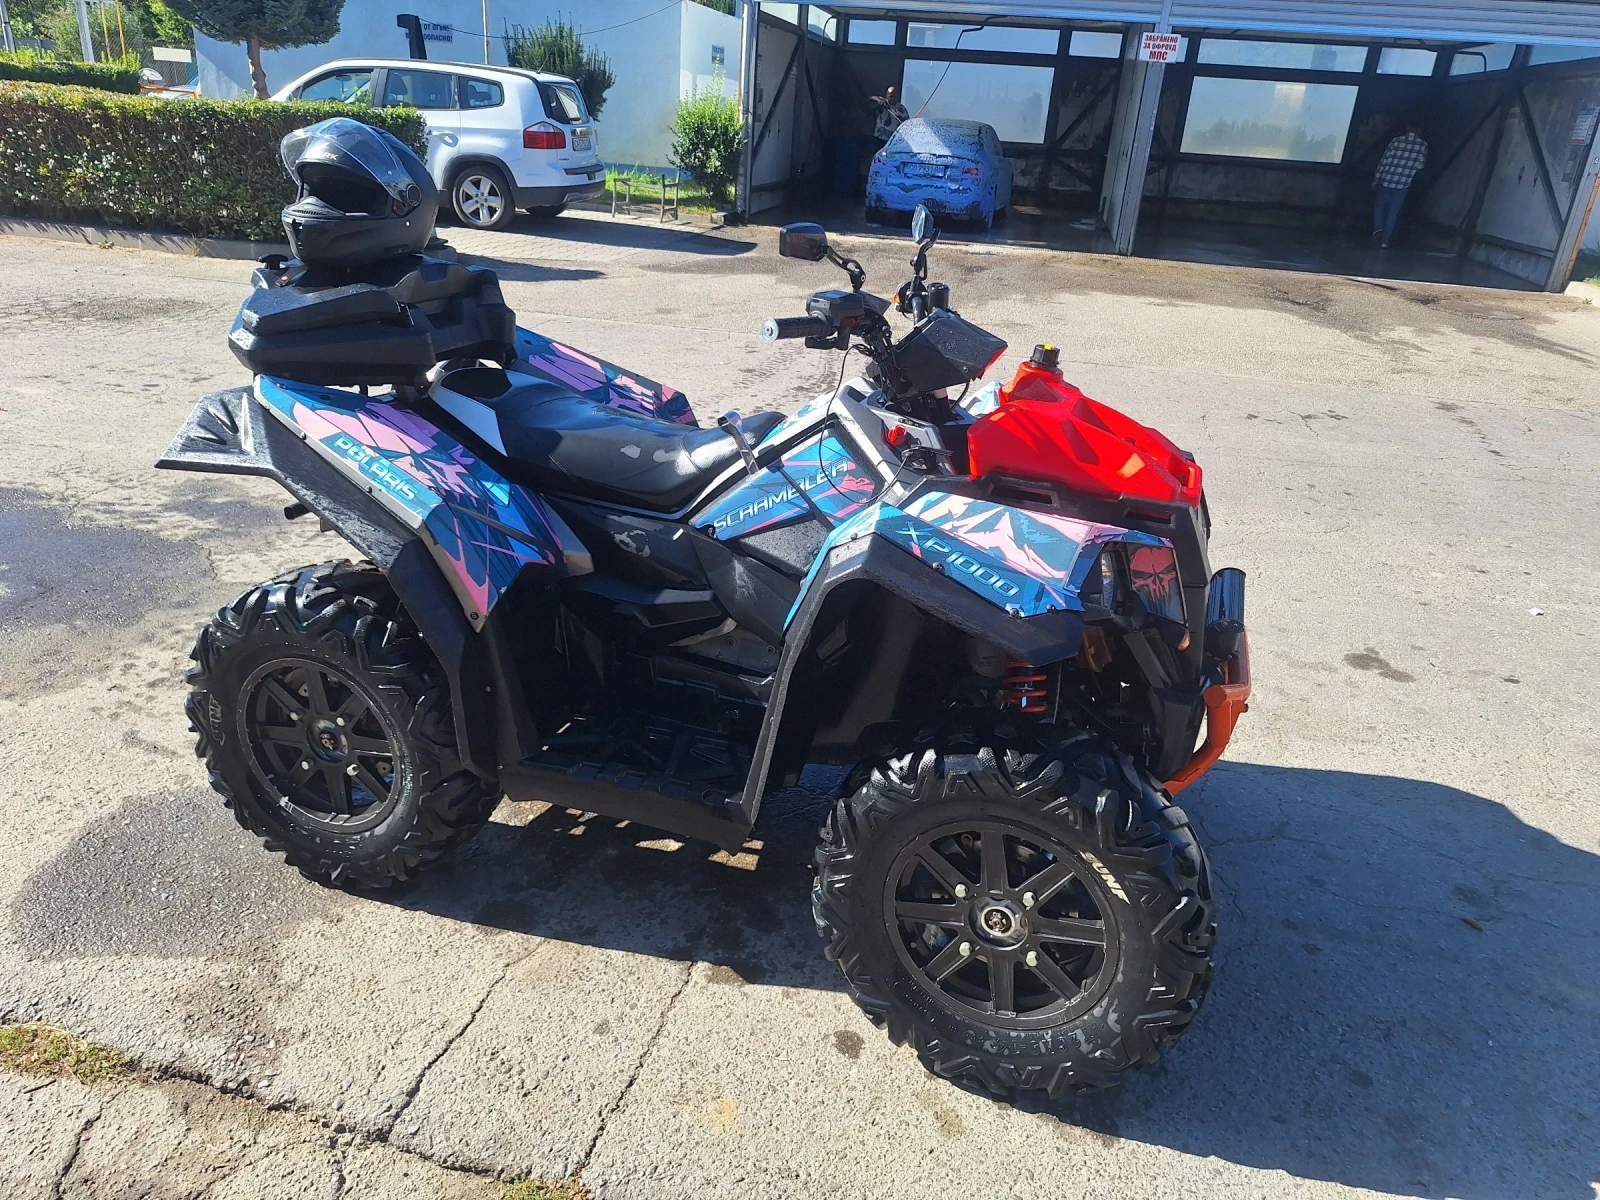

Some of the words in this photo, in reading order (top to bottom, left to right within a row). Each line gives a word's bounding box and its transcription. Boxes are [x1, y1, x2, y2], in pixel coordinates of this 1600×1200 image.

[1143, 42, 1151, 50] ЗА
[1152, 43, 1177, 51] ОФРОУД
[1144, 34, 1179, 43] ЗАБРАНЕНО
[1149, 51, 1168, 61] МПС
[333, 434, 420, 501] POLARIS
[713, 457, 849, 534] SCRAMBLER
[895, 520, 1020, 598] XP1000
